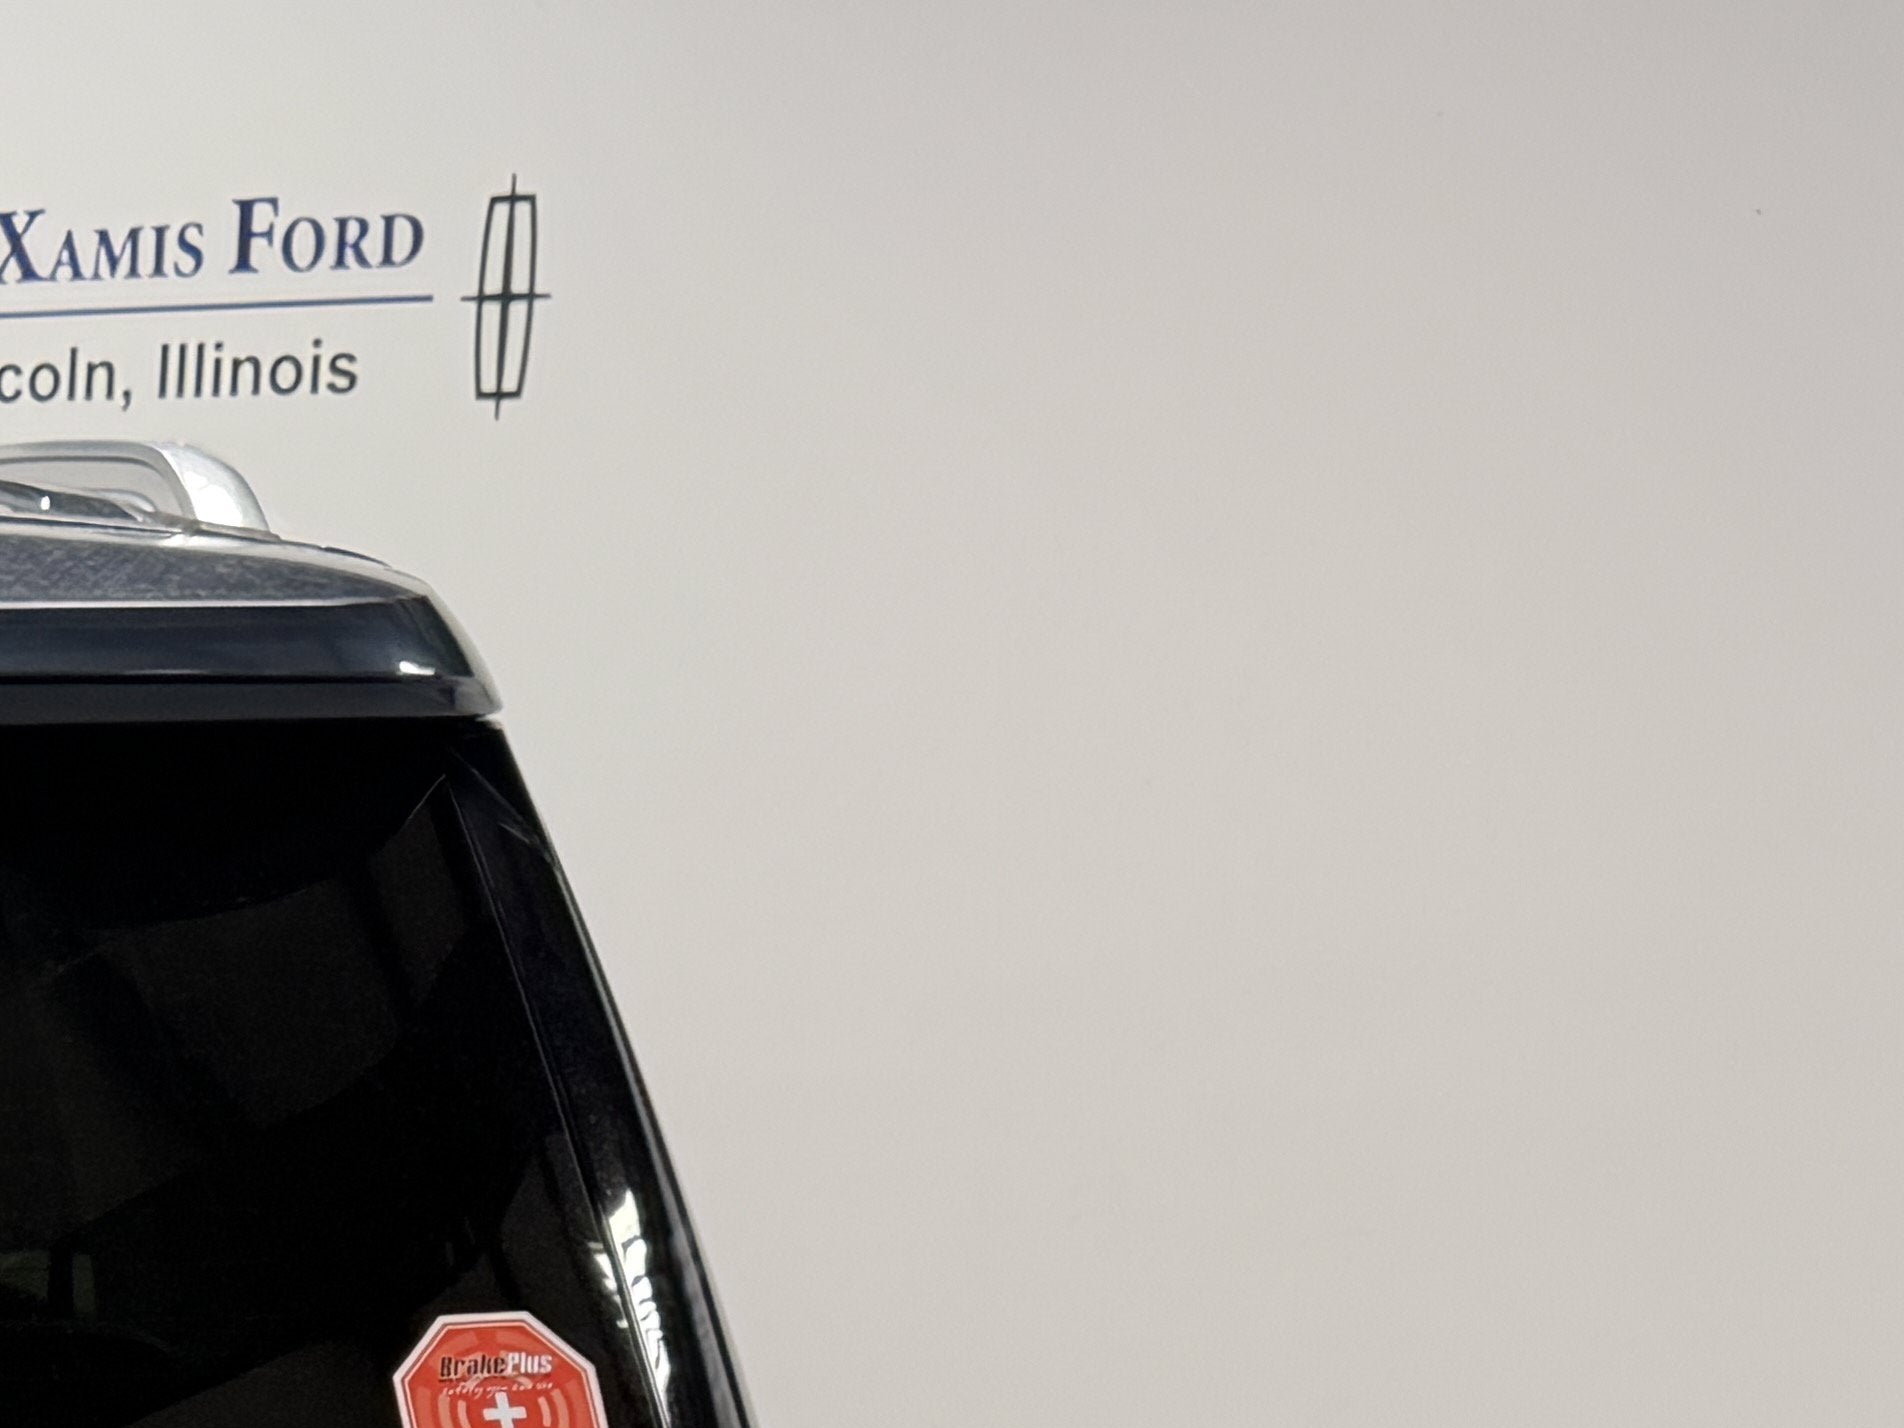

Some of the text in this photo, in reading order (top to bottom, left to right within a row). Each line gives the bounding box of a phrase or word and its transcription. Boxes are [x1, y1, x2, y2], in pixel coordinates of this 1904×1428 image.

[228, 196, 424, 275] FORD
[157, 338, 358, 400] Illinois
[439, 1354, 553, 1378] BrakePlus
